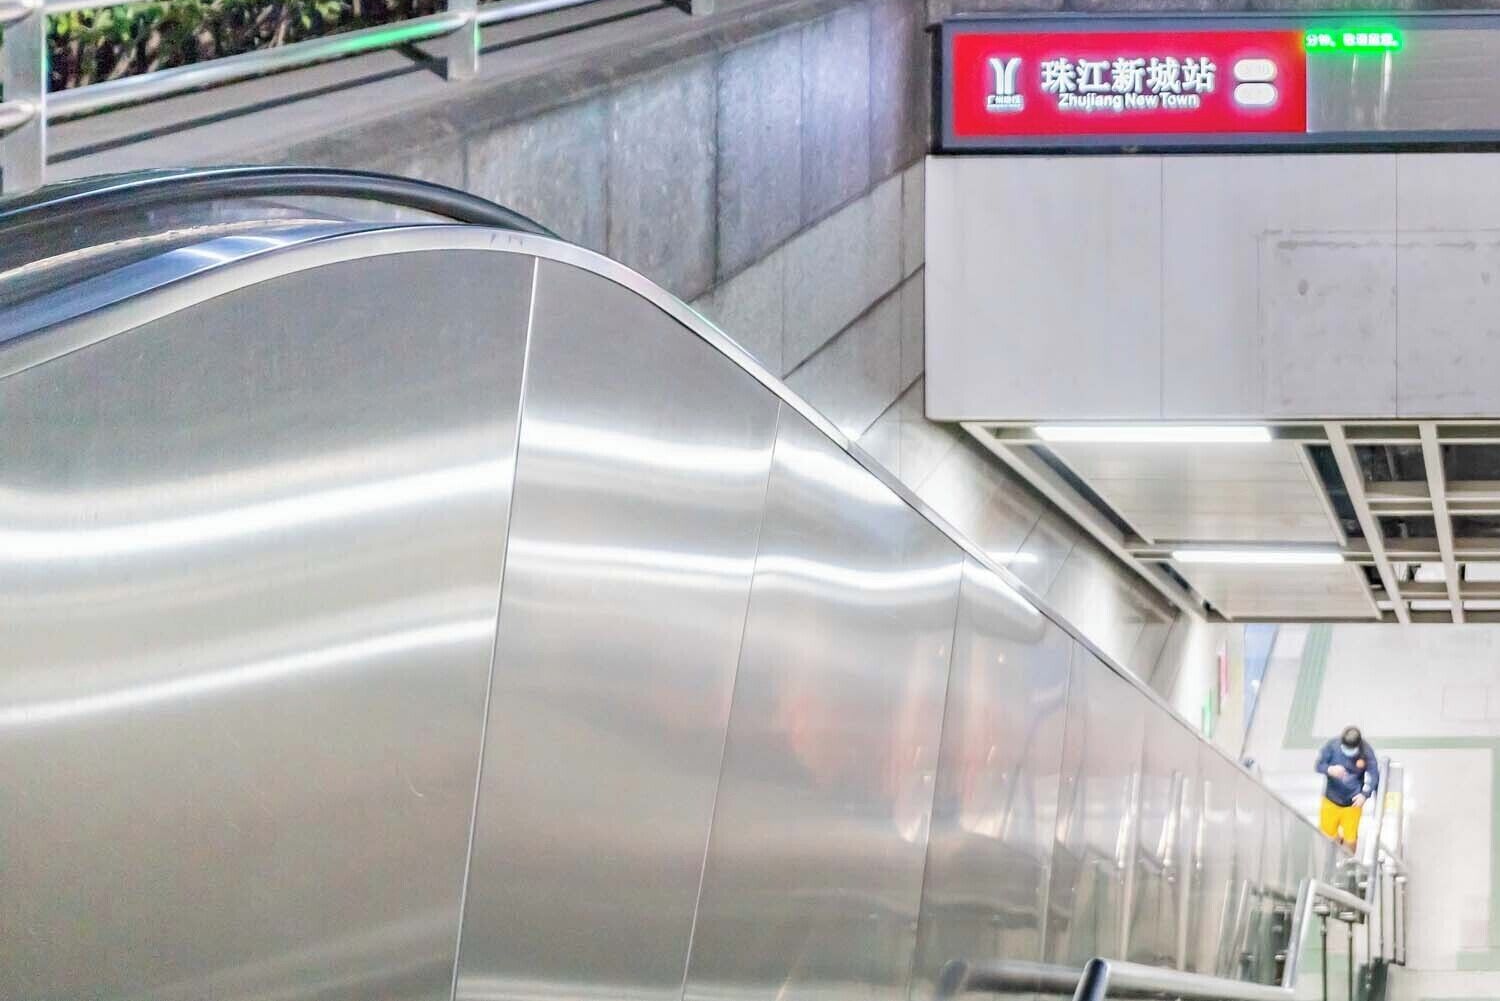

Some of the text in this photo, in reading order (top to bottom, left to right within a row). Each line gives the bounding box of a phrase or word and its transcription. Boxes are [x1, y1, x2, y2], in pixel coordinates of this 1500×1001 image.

[1040, 57, 1216, 93] 珠江新城站
[1058, 92, 1200, 112] Zhujiang New Town
